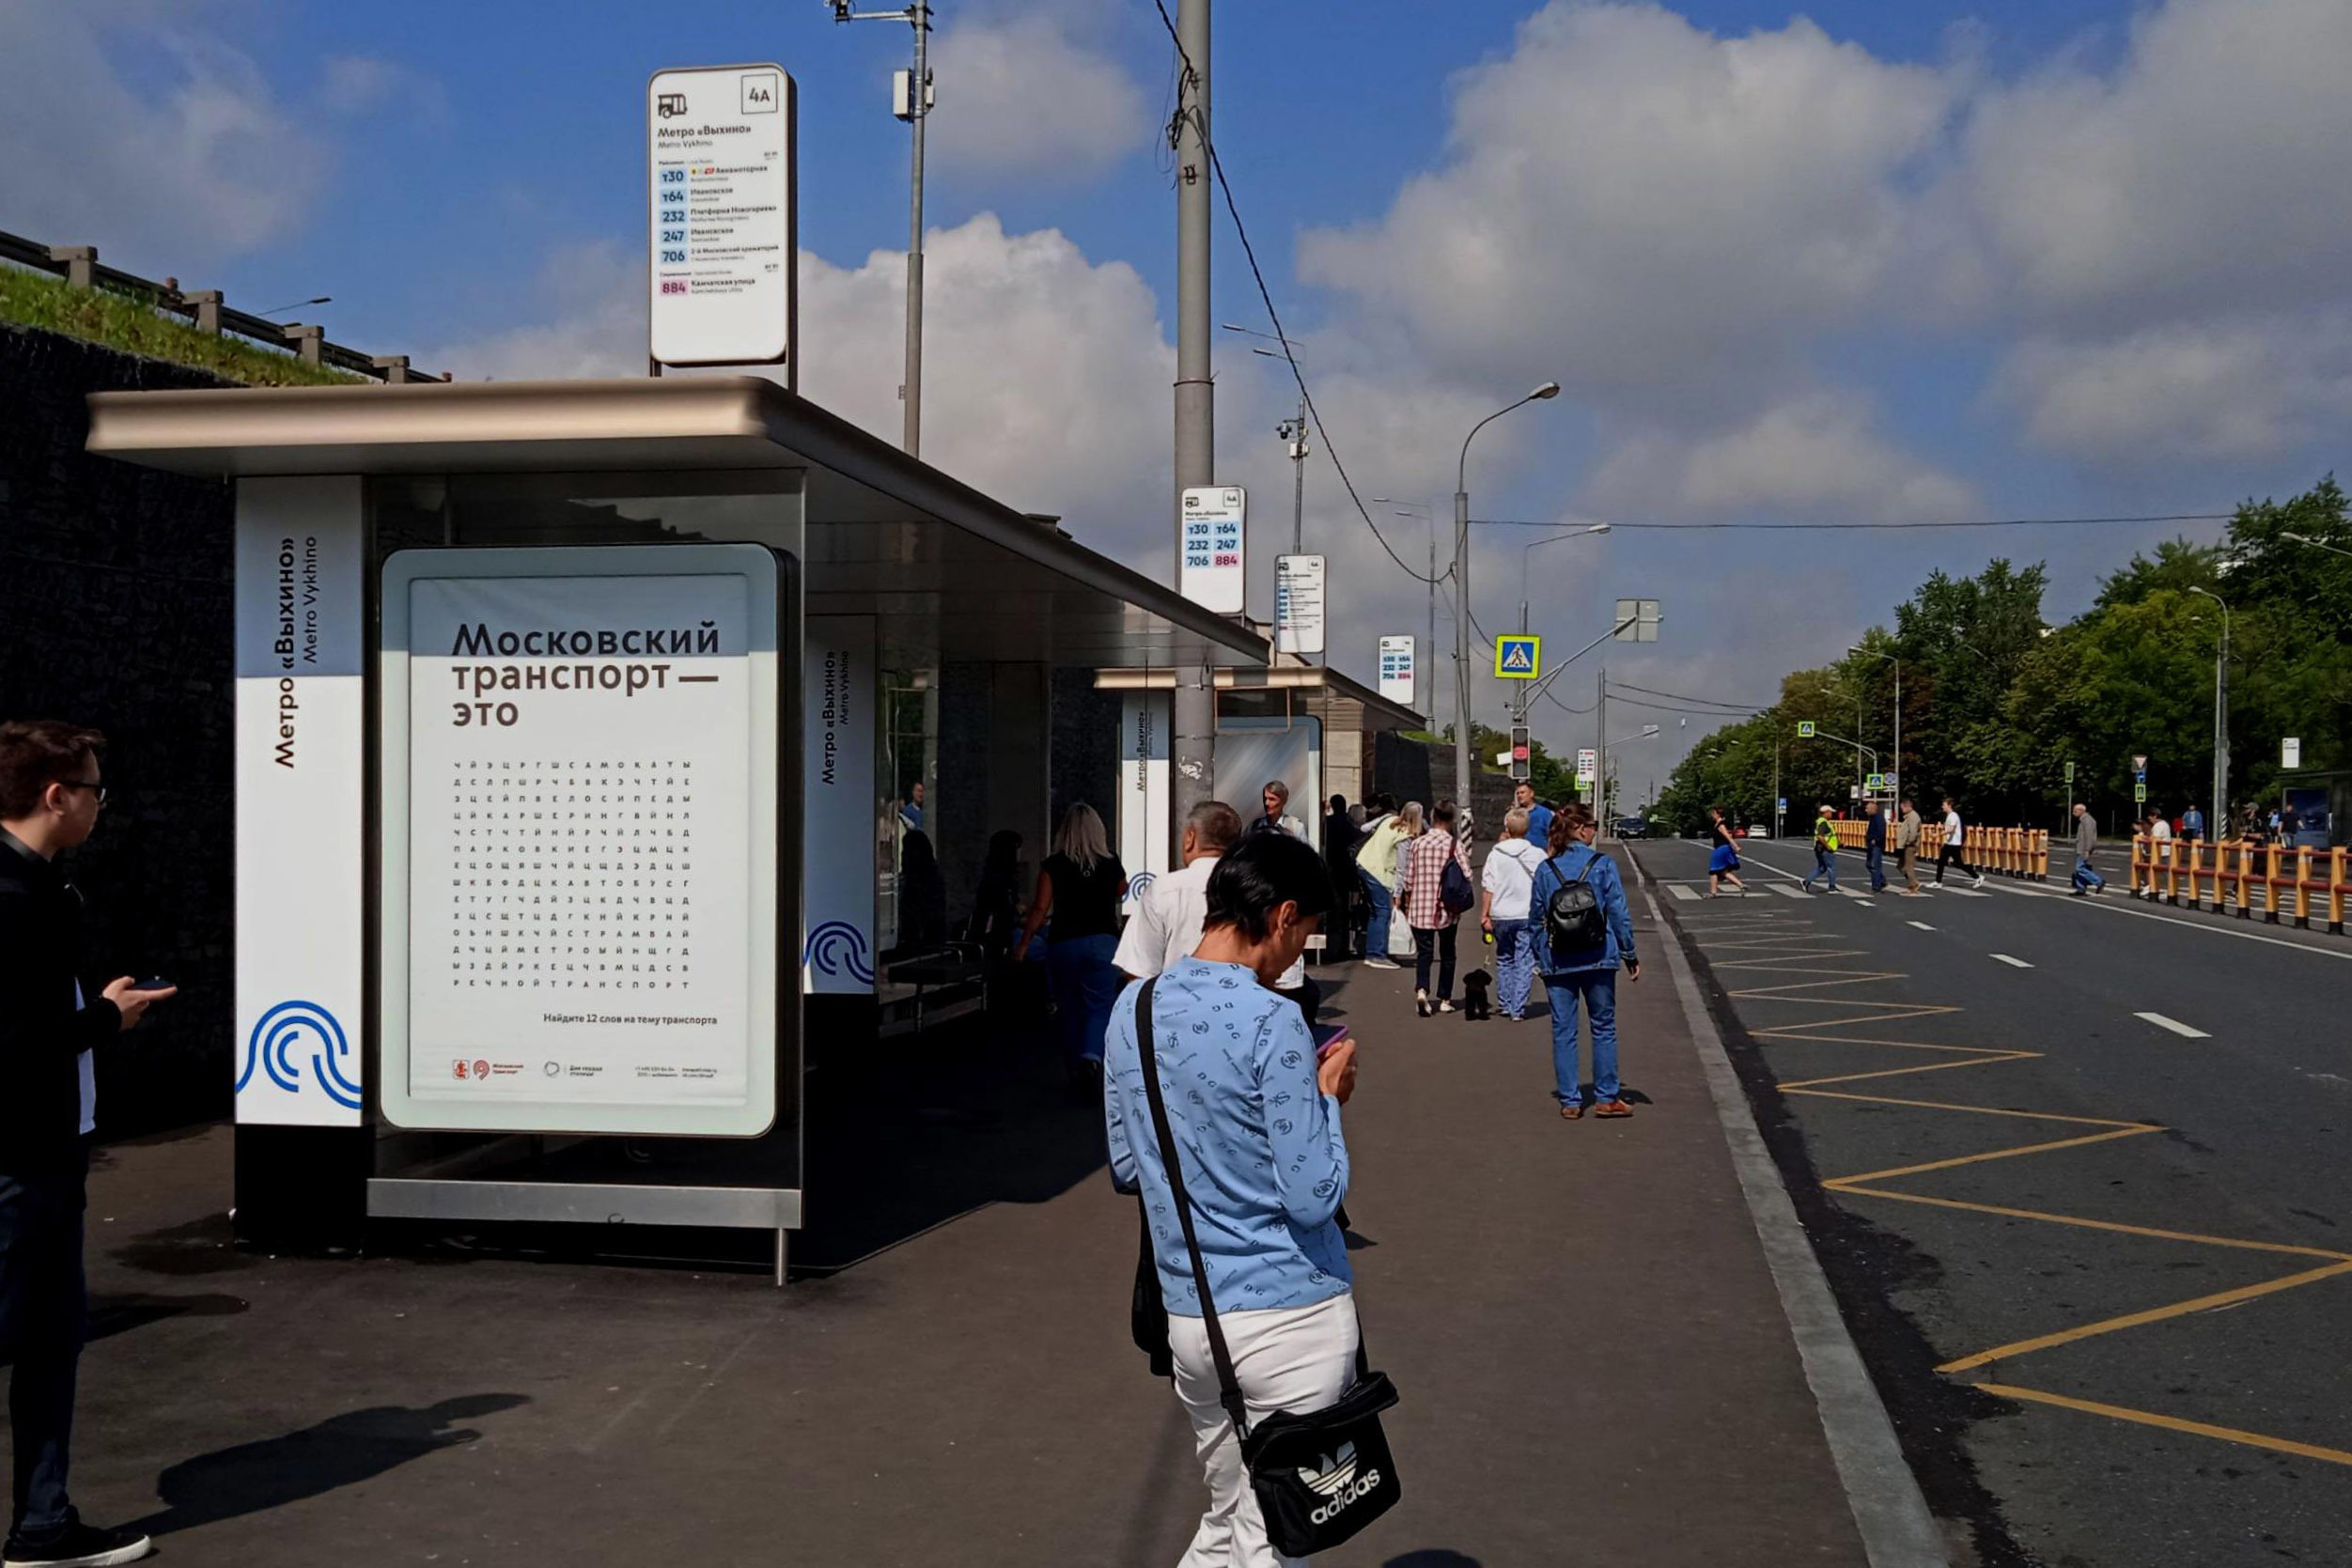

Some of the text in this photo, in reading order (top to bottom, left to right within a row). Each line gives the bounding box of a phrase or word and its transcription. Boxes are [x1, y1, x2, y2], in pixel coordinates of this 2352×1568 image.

[749, 87, 770, 101] 4А
[658, 125, 751, 138] Метро «Выхино»
[662, 171, 684, 182] т30
[662, 191, 684, 202] т64
[662, 210, 685, 222] 232
[663, 230, 685, 242] 247
[662, 251, 685, 262] 706
[662, 282, 686, 293] 884
[1189, 523, 1237, 535] т30 т64
[1188, 539, 1237, 551] 232 247
[1188, 555, 1237, 567] 706 884
[303, 536, 319, 663] Metro Vykhino
[451, 620, 719, 657] Московский
[274, 537, 299, 768] Метро «Выхино»
[452, 702, 519, 726] это
[822, 651, 837, 785] Метро «Выхино»
[543, 1013, 584, 1024] Найдите
[586, 1014, 598, 1023] 12
[637, 1017, 661, 1026] тему
[662, 1017, 718, 1026] транспорта
[1310, 1468, 1381, 1524] adidas
